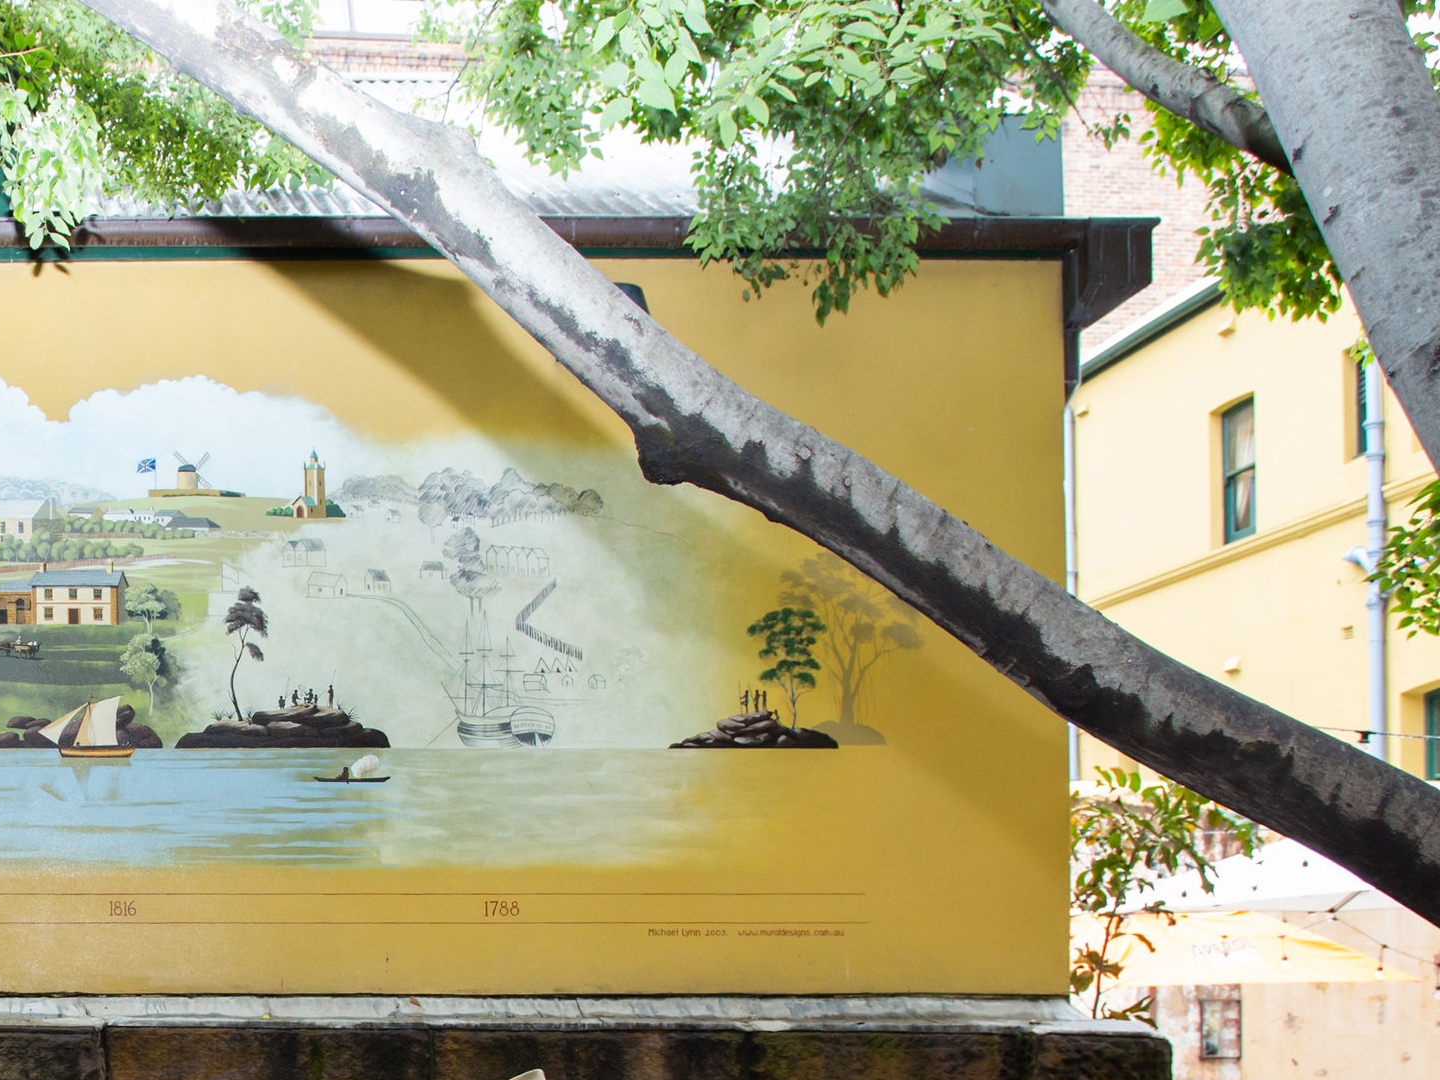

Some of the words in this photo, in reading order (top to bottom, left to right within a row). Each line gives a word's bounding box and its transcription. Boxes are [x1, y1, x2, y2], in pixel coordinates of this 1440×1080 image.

[108, 900, 137, 917] 1816
[483, 900, 520, 917] 1788
[648, 928, 679, 937] Michael
[681, 928, 701, 938] Lynn
